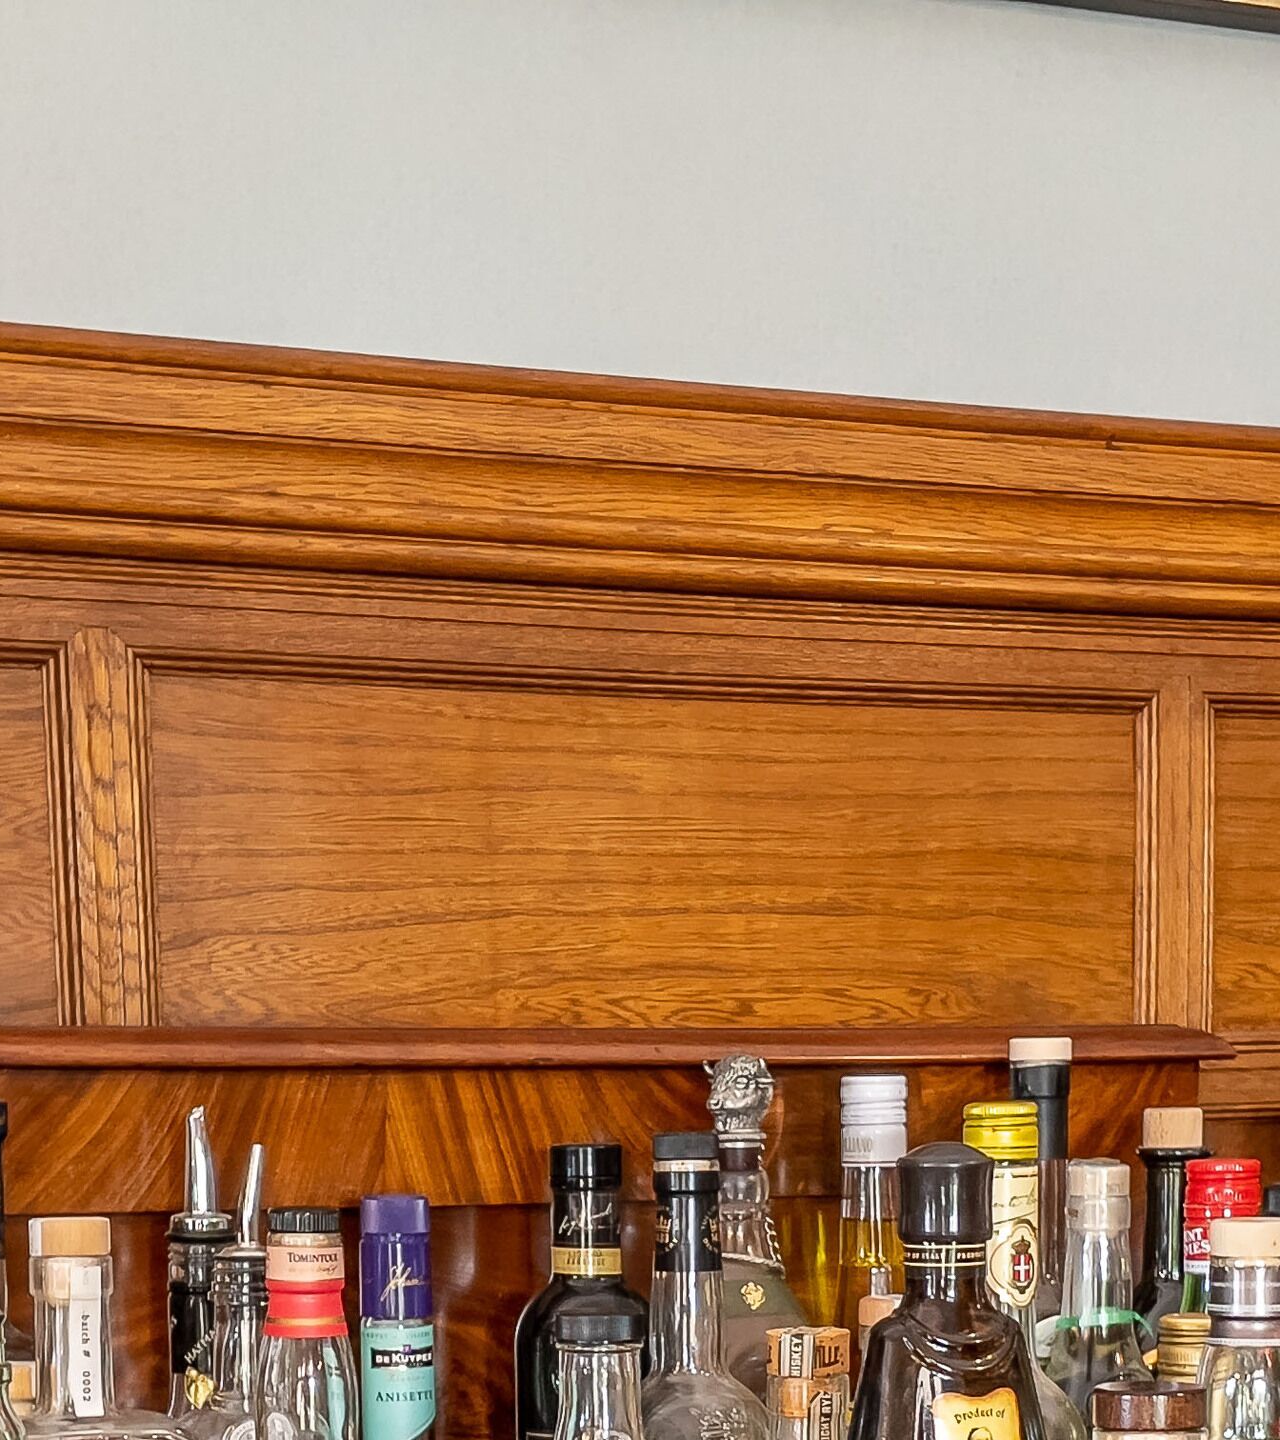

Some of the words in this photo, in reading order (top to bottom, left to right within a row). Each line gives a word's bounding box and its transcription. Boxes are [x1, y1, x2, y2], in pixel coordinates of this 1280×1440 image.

[184, 1331, 216, 1365] HAYMA
[790, 1337, 803, 1377] HISKEY
[954, 1408, 993, 1424] product
[996, 1408, 1006, 1418] of
